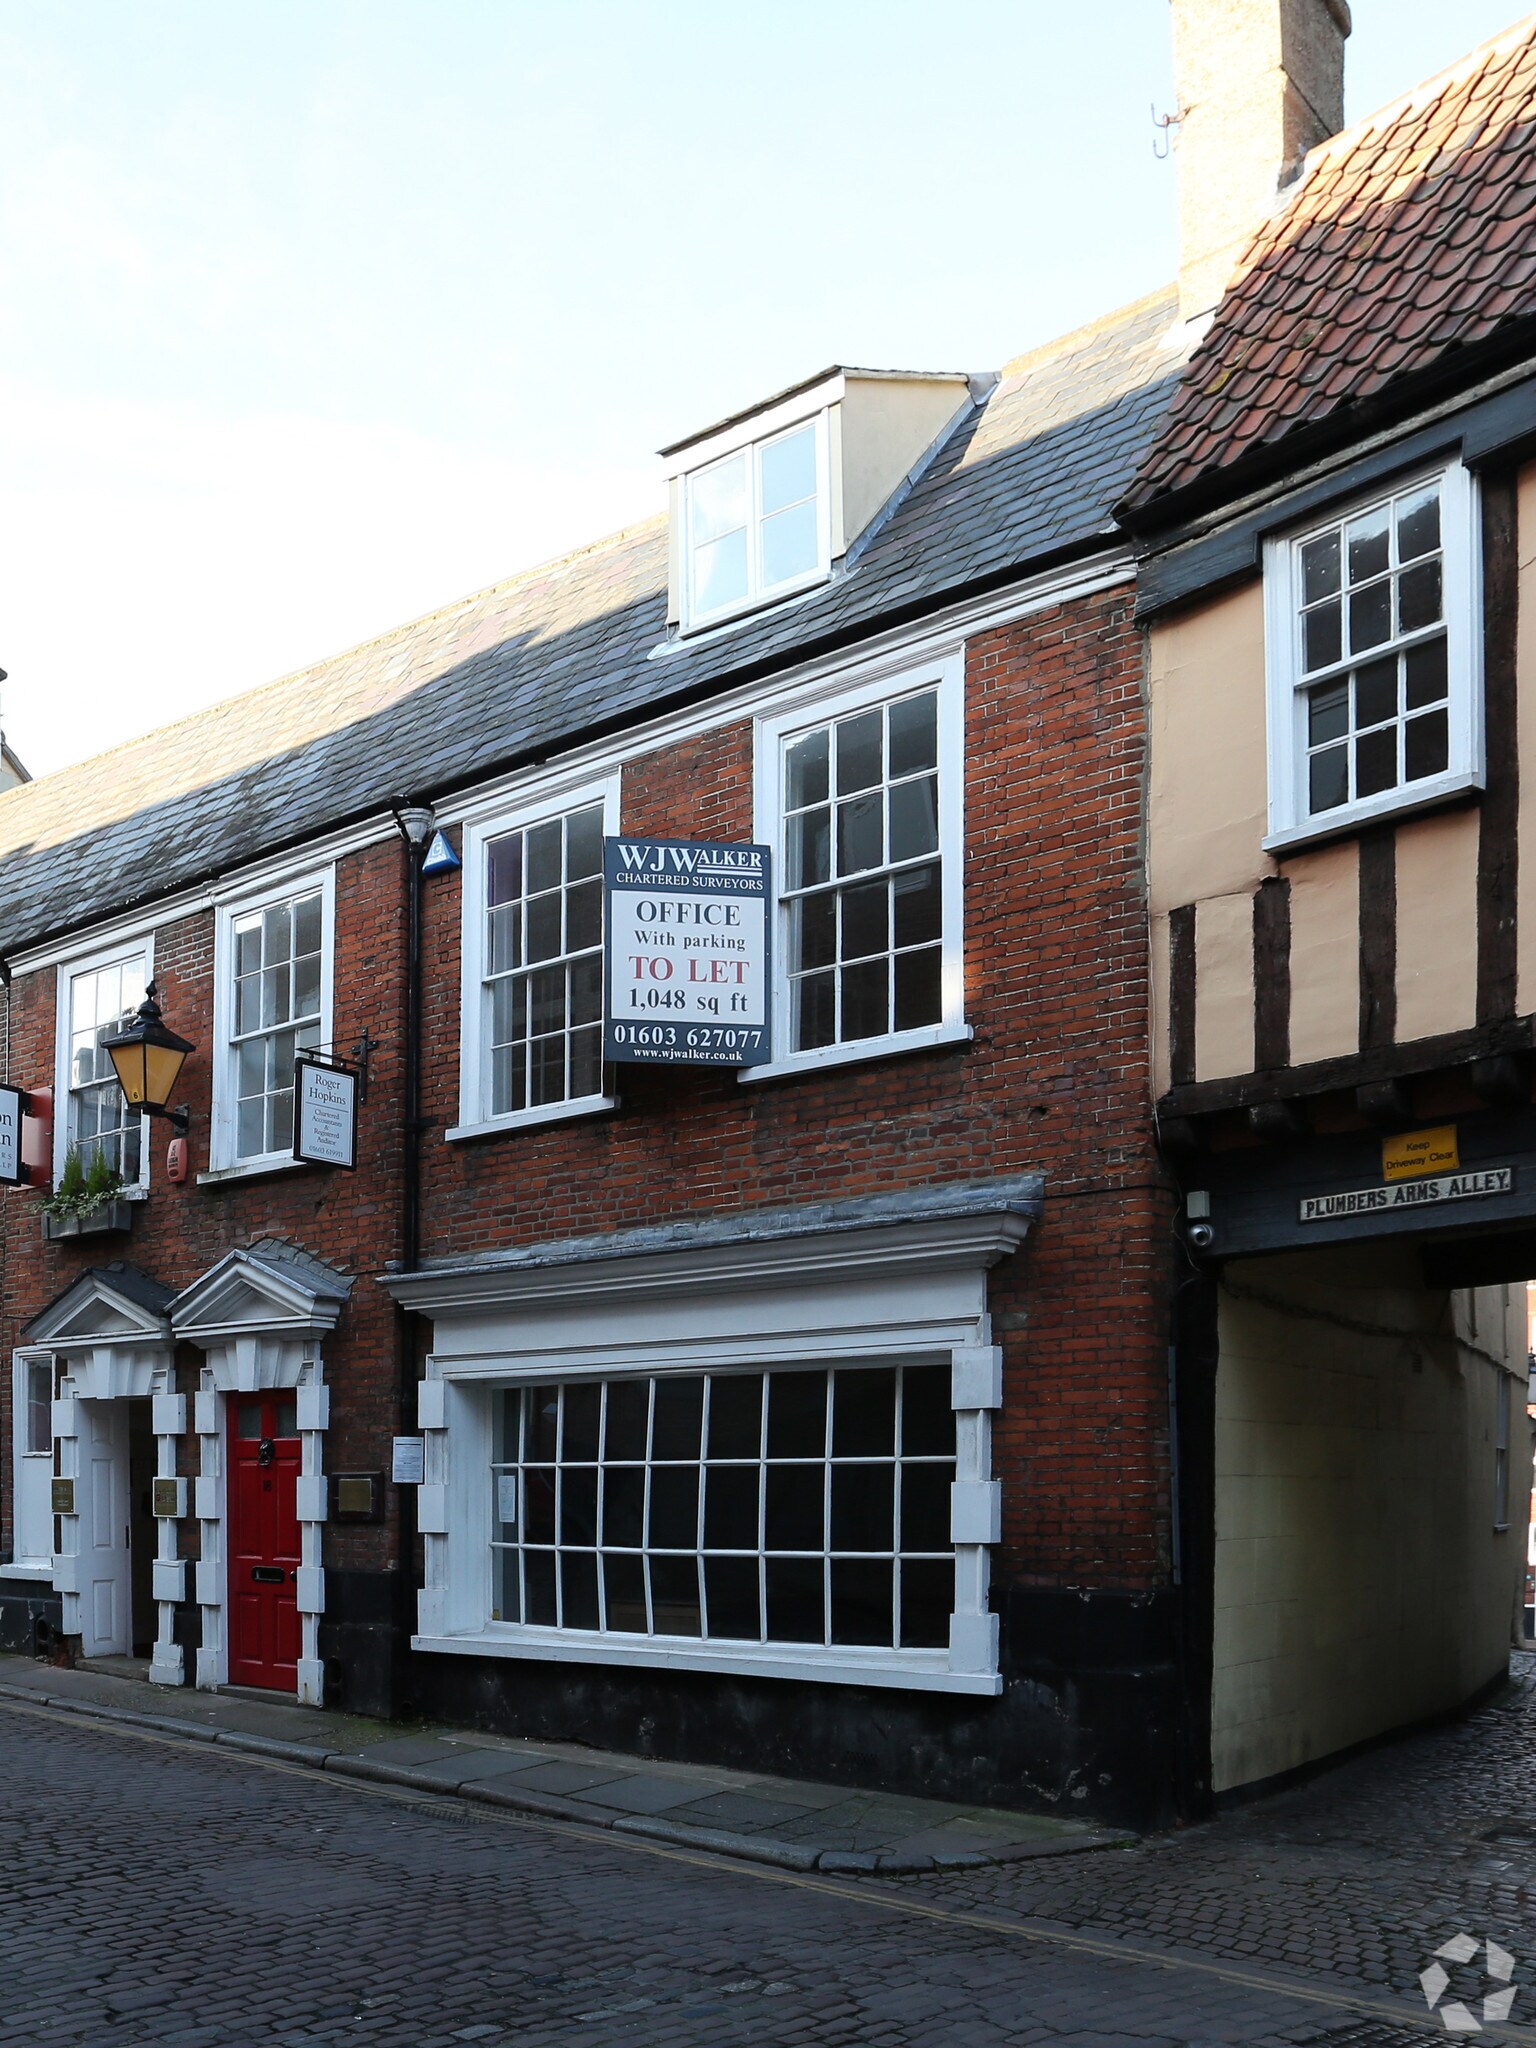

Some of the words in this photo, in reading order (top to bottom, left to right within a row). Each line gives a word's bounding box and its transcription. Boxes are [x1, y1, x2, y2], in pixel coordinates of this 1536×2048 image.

[616, 872, 690, 887] CHARTERED
[692, 876, 764, 891] SURVEYORS
[636, 900, 741, 926] OFFICE
[634, 929, 675, 946] With
[683, 934, 746, 951] parking
[628, 956, 674, 981] TO
[687, 958, 750, 984] LET
[629, 988, 686, 1012] 1,048
[696, 996, 719, 1015] sq
[730, 992, 748, 1012] ft
[614, 1025, 676, 1045] 01603
[687, 1029, 762, 1048] 627077
[633, 1048, 743, 1061] www.wjwalker.co.uk
[315, 1074, 341, 1090] Roger
[309, 1087, 346, 1105] Hopkins
[314, 1109, 340, 1120] Chartered
[1406, 1141, 1430, 1152] Keep
[1386, 1156, 1426, 1170] Driveway
[1429, 1150, 1454, 1162] Clear
[1306, 1189, 1387, 1217] PLUMBERS
[1394, 1182, 1440, 1204] ARMS
